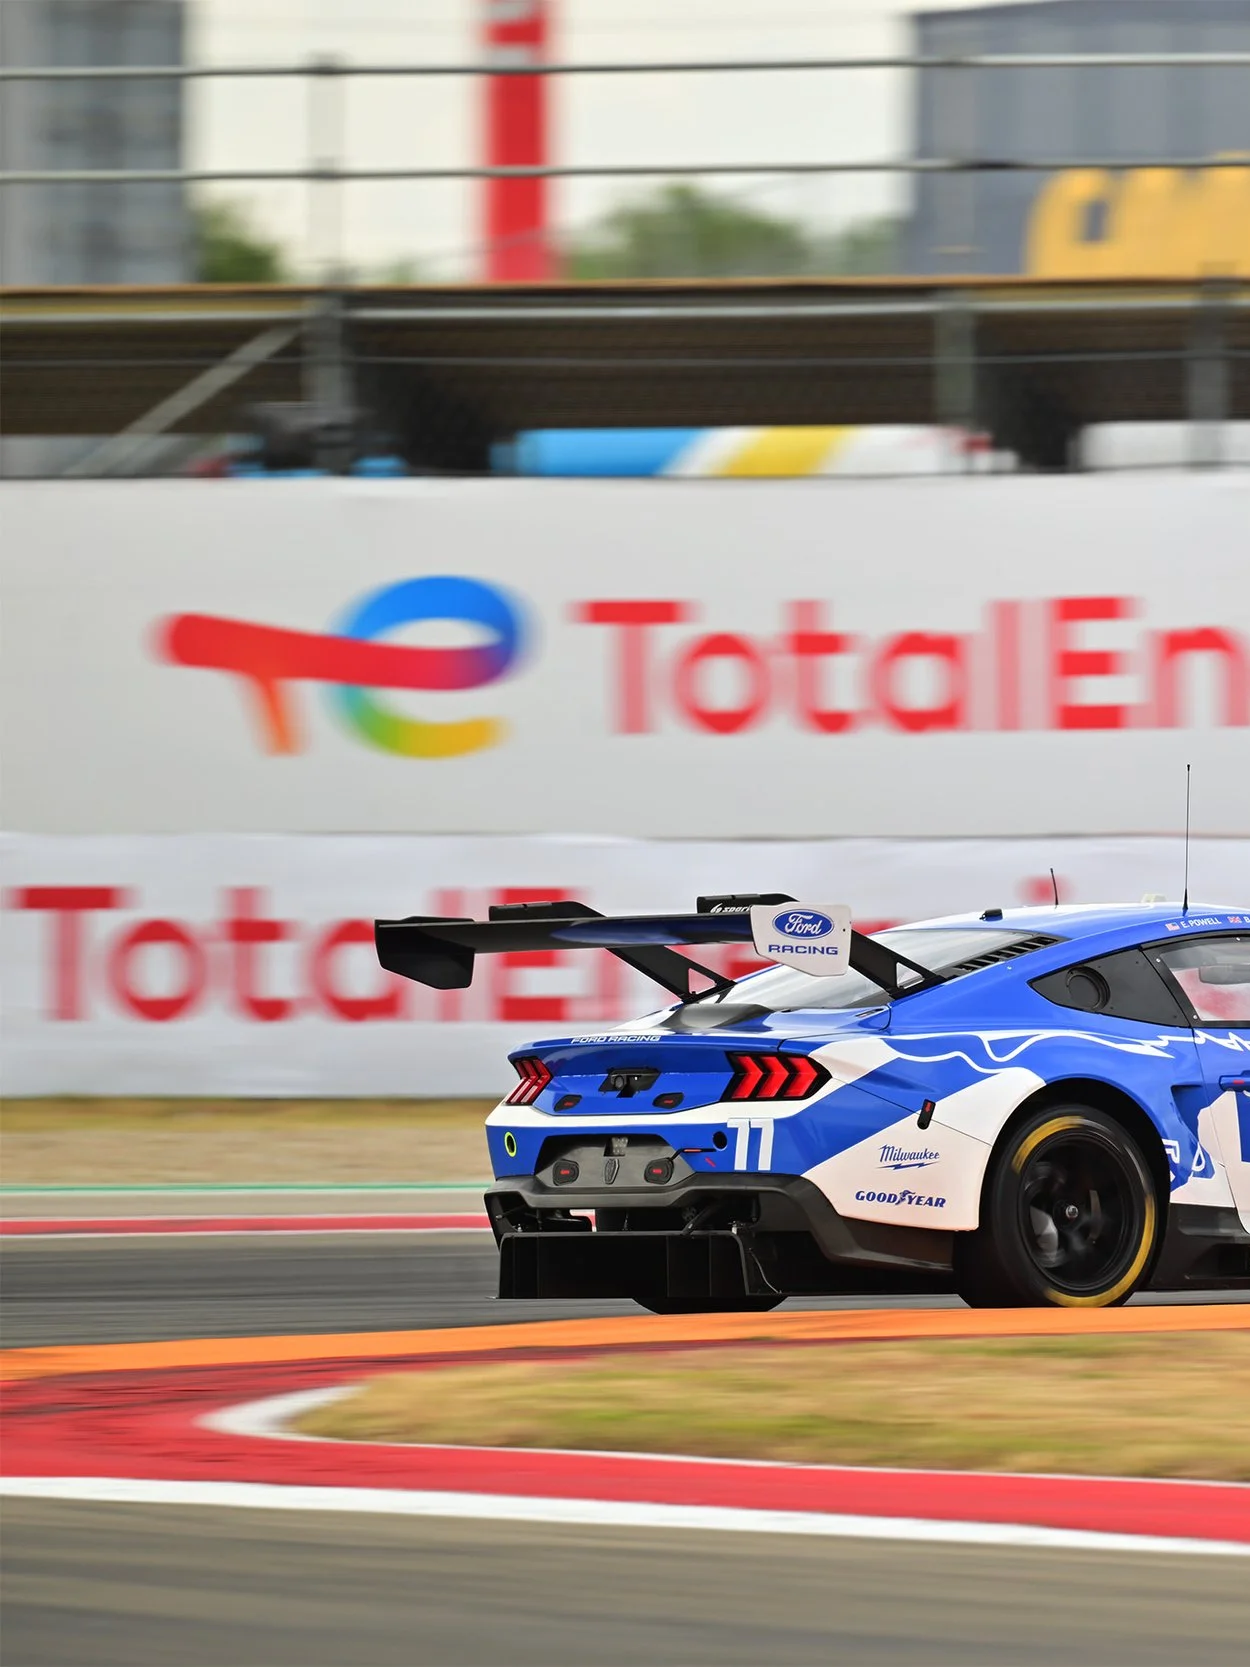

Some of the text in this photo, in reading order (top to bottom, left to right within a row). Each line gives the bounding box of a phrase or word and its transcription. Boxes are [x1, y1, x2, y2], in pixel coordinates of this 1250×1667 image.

[785, 913, 822, 934] Ford
[1189, 917, 1222, 927] POWELL
[768, 944, 838, 955] RACING
[571, 1036, 607, 1044] FORD
[727, 1117, 774, 1171] 77
[878, 1144, 940, 1162] Milwaukee
[855, 1190, 946, 1208] GOODYEAR
